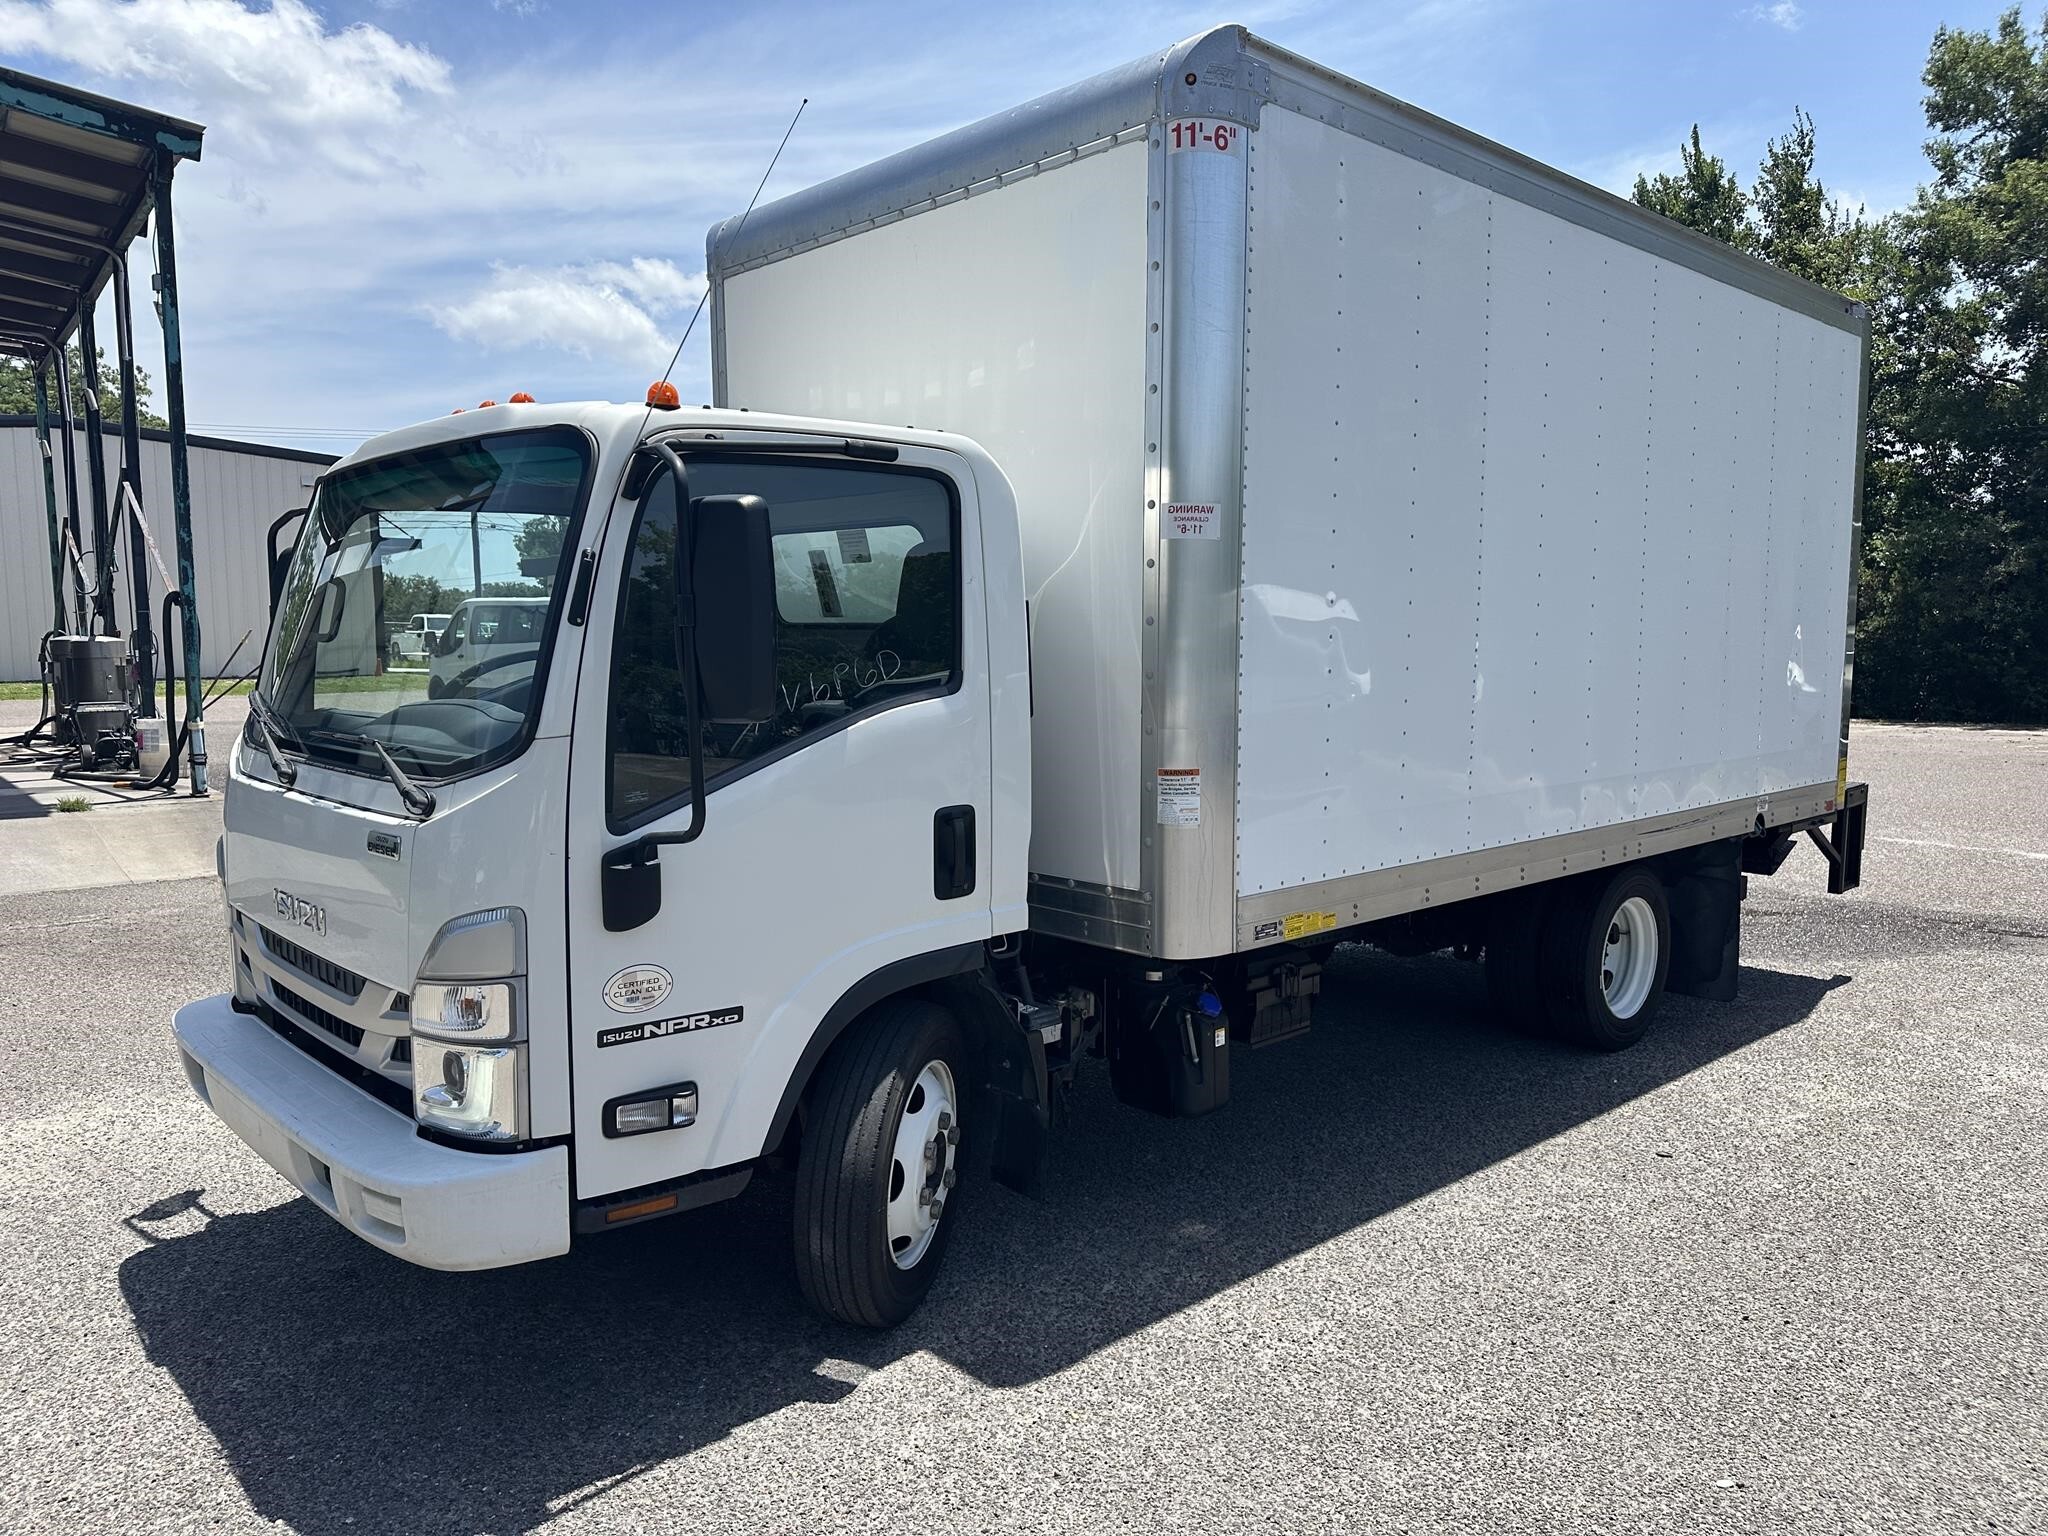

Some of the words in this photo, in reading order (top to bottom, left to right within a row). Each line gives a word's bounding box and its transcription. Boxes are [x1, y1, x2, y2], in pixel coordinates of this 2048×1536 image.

[1171, 122, 1236, 151] 11'-6"
[273, 887, 327, 937] ISUZU
[617, 977, 660, 990] CERTIFIED
[613, 988, 642, 999] CLEAN
[645, 984, 663, 994] IDLE
[603, 1029, 642, 1043] ISUZU
